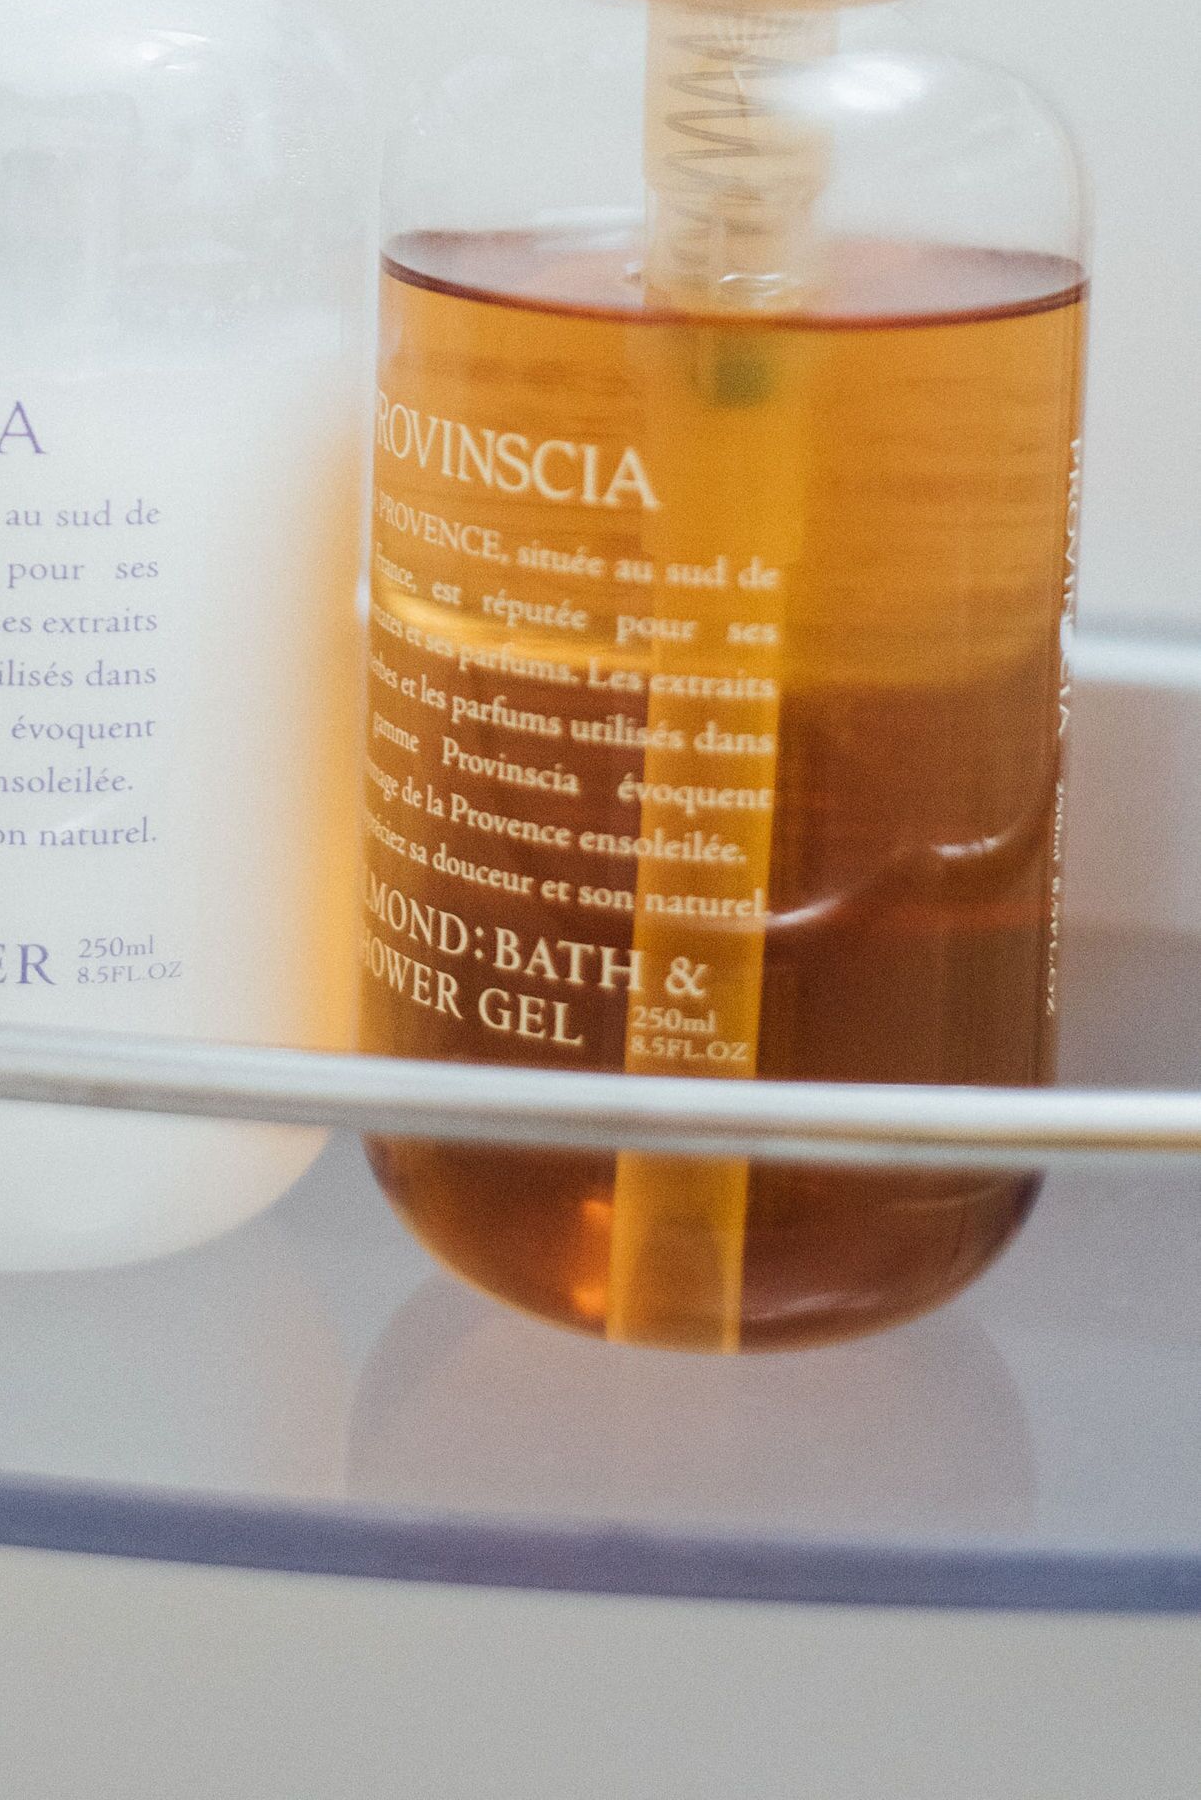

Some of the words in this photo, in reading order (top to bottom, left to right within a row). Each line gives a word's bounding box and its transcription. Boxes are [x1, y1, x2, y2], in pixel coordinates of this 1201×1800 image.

[375, 388, 661, 512] ROVINSCIA
[5, 508, 42, 527] au
[55, 499, 113, 528] sud
[124, 498, 162, 527] de
[379, 491, 510, 566] PROVENCE,
[516, 539, 605, 577] située
[615, 557, 654, 584] au
[664, 555, 727, 588] sud
[737, 556, 780, 591] de
[7, 561, 85, 589] pour
[115, 560, 159, 579] ses
[41, 606, 159, 634] extraits
[432, 581, 462, 606] est
[482, 589, 589, 631] réputée
[616, 612, 698, 646] pour
[727, 621, 779, 646] ses
[85, 659, 157, 686] dans
[406, 623, 425, 648] et
[426, 632, 454, 658] ses
[459, 638, 579, 686] parfums.
[587, 658, 642, 693] Les
[649, 669, 777, 700] extraits
[10, 715, 156, 748] évoquent
[401, 677, 416, 698] et
[420, 674, 447, 710] les
[451, 694, 562, 736] parfums
[570, 713, 684, 751] utilisés
[693, 721, 775, 756] dans
[442, 736, 580, 796] Provinscia
[617, 772, 772, 817] évoquent
[39, 817, 157, 846] naturel.
[402, 777, 423, 806] de
[426, 786, 445, 818] la
[450, 792, 571, 848] Provence
[579, 828, 747, 865] ensoleilée.
[409, 841, 428, 865] sa
[432, 842, 533, 896] douceur
[541, 878, 571, 901] et
[577, 884, 635, 911] son
[644, 888, 771, 920] naturel.
[77, 935, 155, 959] 250ml
[664, 955, 709, 999] &
[478, 986, 584, 1048] GEL
[632, 1005, 717, 1036] 250ml
